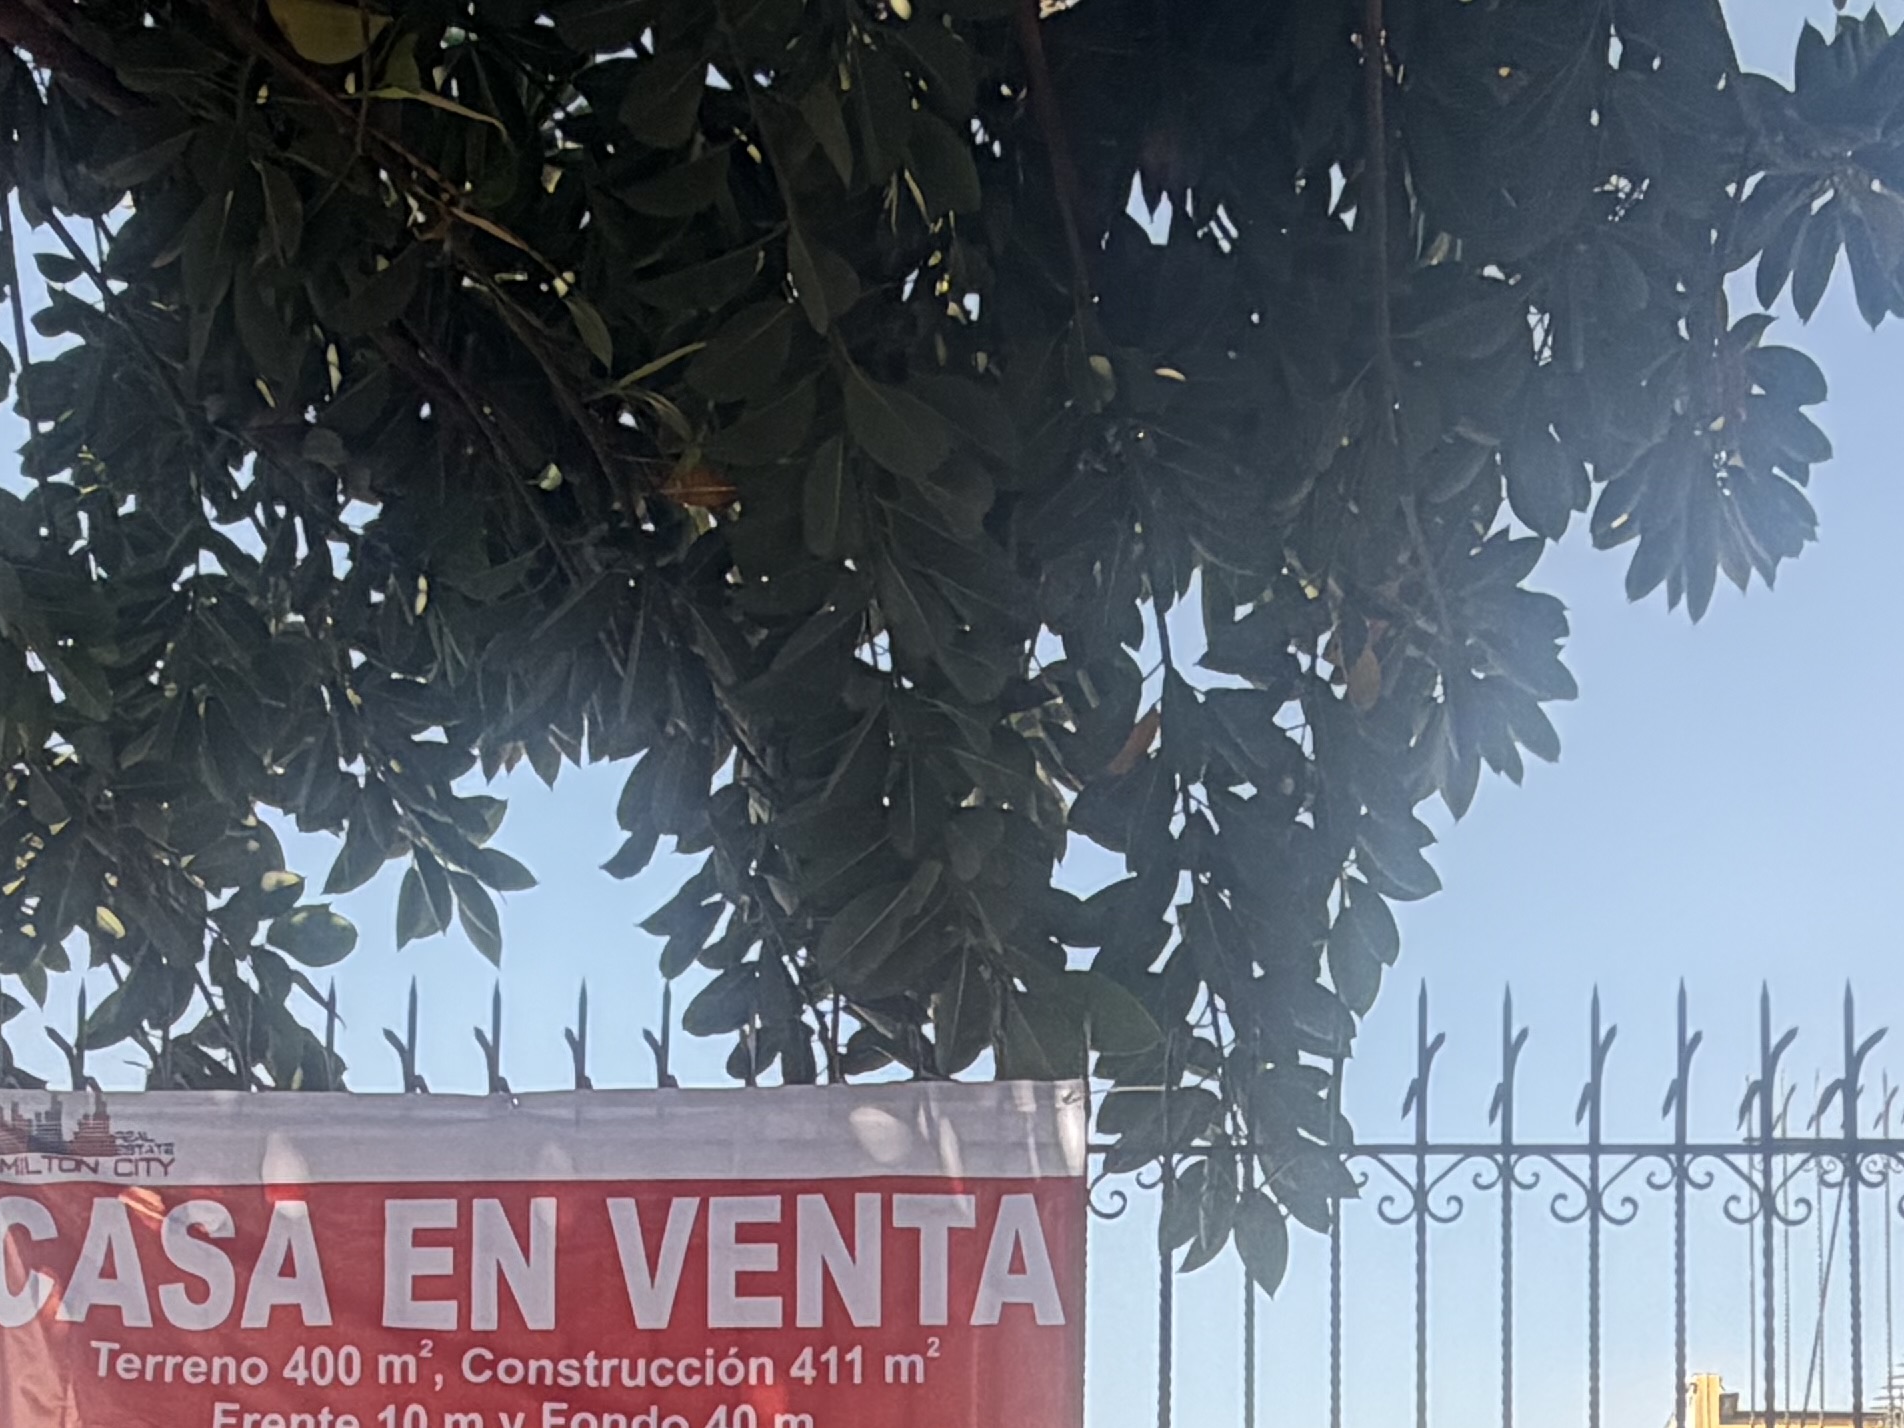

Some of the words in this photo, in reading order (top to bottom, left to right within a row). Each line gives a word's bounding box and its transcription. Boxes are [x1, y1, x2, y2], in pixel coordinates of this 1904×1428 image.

[113, 1157, 175, 1178] CITY
[382, 1197, 557, 1332] EN
[606, 1192, 1067, 1331] VENTA
[91, 1340, 269, 1386] Terreno
[282, 1345, 362, 1387] 400
[461, 1346, 775, 1388] Construcción
[789, 1344, 864, 1385] 411
